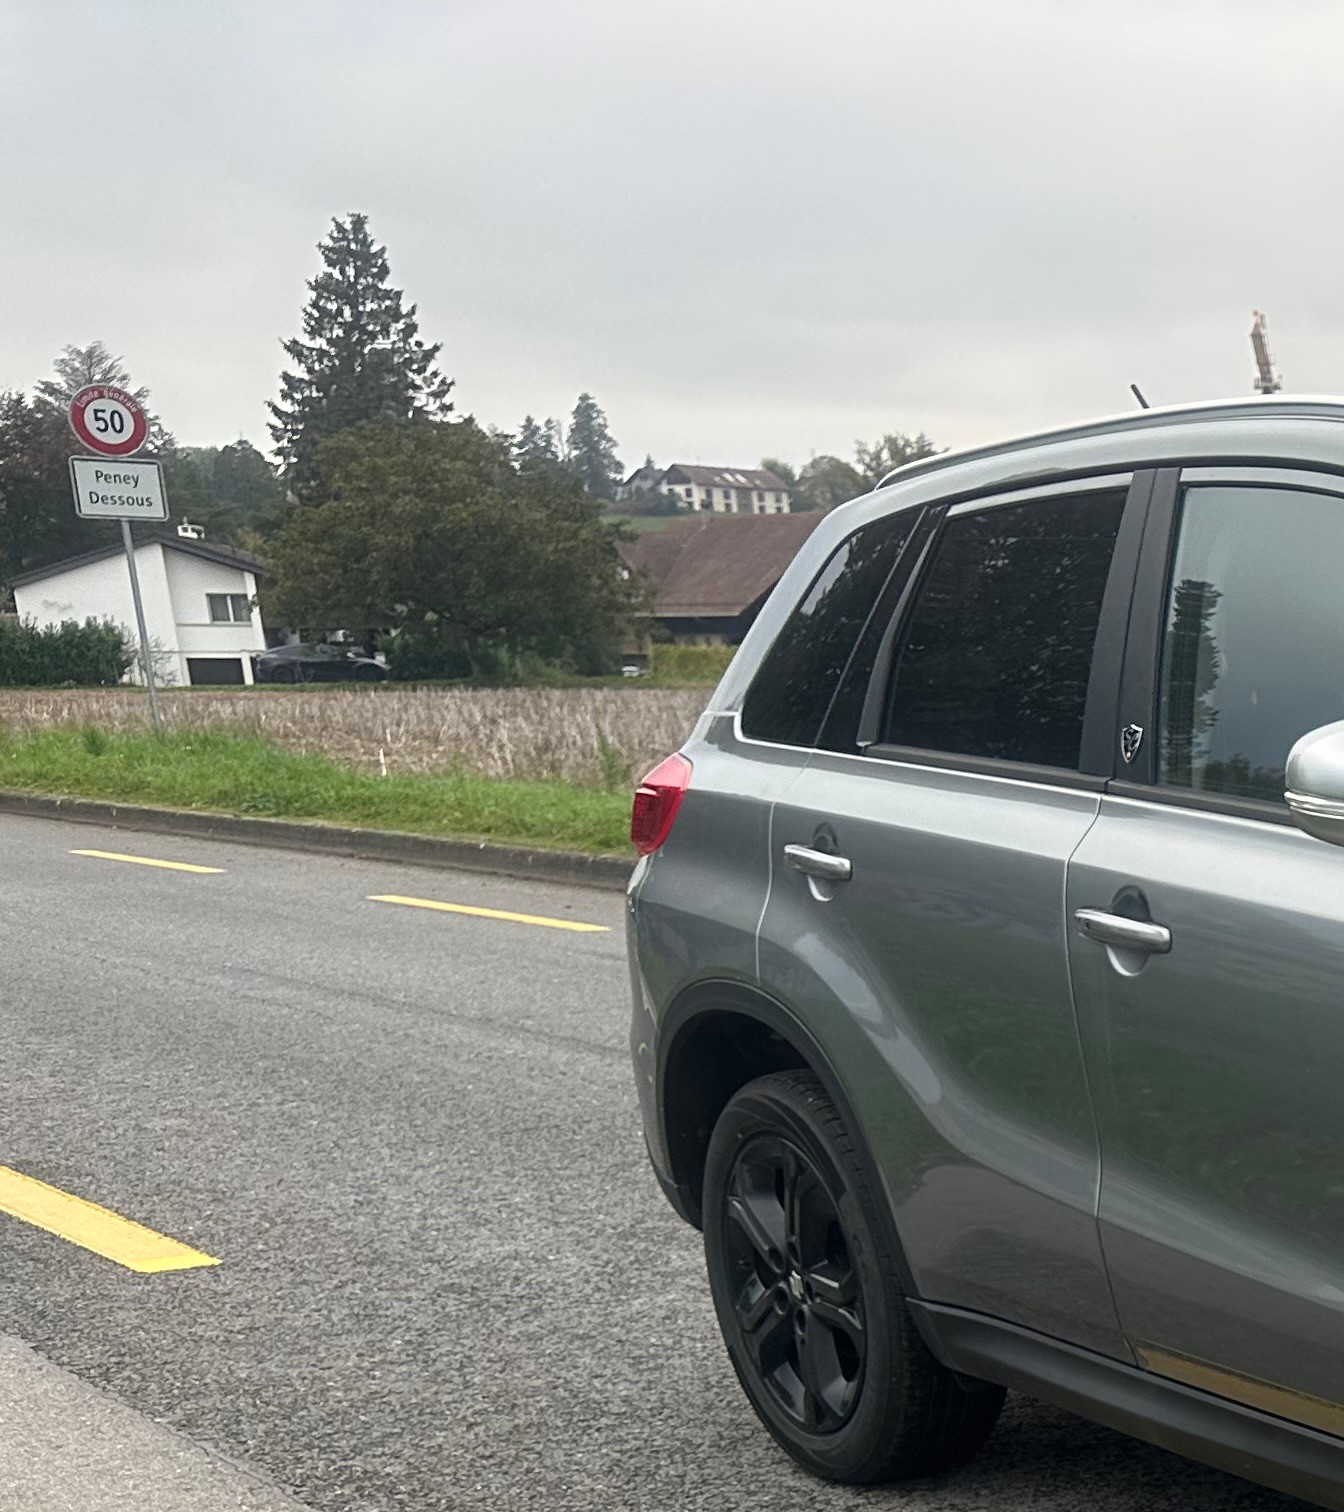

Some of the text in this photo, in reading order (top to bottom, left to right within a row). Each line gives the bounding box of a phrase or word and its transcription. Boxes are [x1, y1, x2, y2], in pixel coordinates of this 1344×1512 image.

[93, 408, 124, 434] 50
[95, 469, 139, 489] Peney
[88, 490, 153, 507] Dessous
